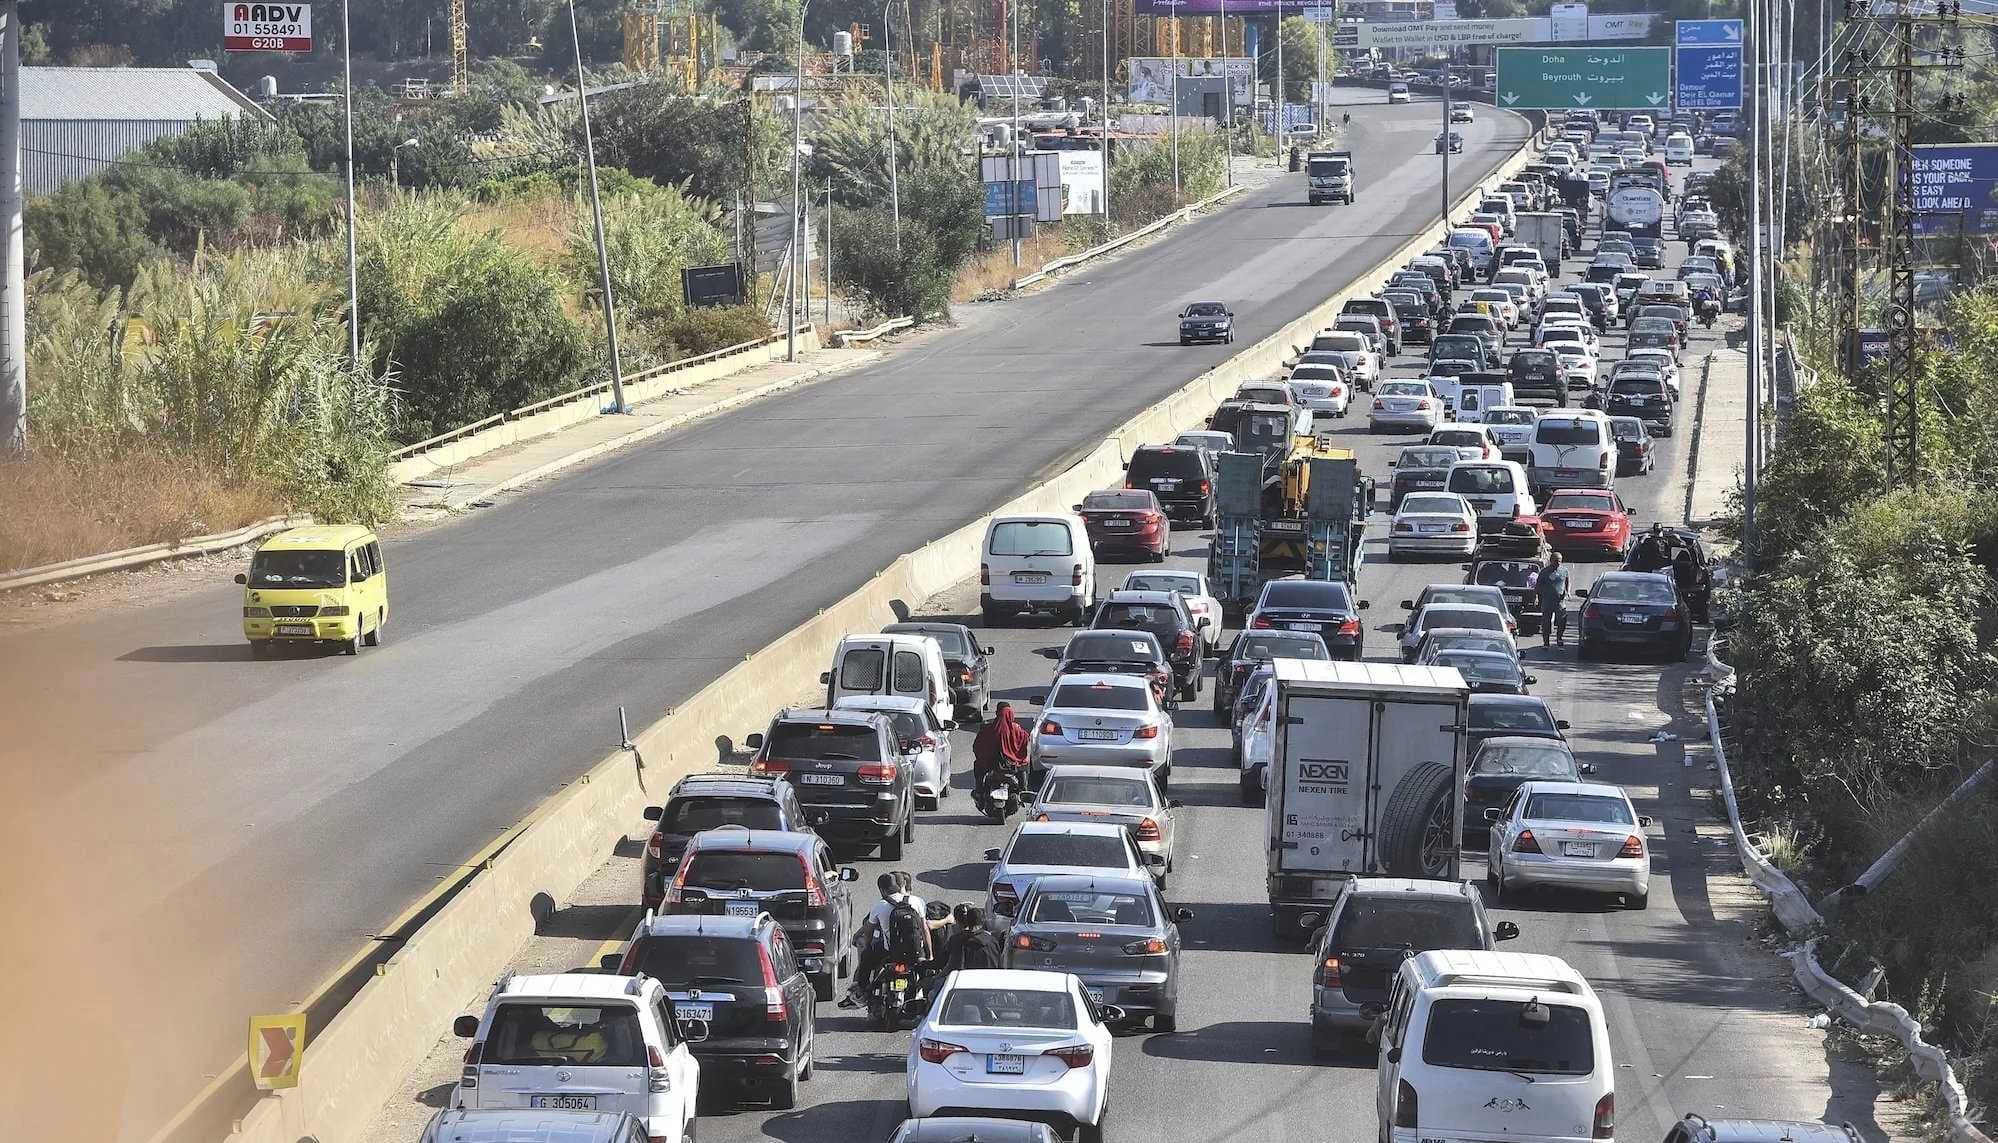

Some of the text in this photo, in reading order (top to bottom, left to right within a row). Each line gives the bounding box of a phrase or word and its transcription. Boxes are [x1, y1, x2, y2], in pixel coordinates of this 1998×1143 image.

[234, 4, 302, 22] AADV
[234, 23, 302, 35] 01 558491
[1372, 26, 1406, 34] Download
[1425, 24, 1438, 32] Pay
[251, 38, 284, 49] G20B
[1542, 55, 1565, 63] Doha
[1586, 54, 1625, 65] الدوحة
[1542, 72, 1582, 83] Beyrouth
[1586, 72, 1625, 84] بيروت
[1931, 158, 1973, 171] SOMEONE
[1923, 172, 1946, 184] YOUR
[1921, 185, 1945, 196] EASY
[1916, 197, 1939, 209] LOOK
[1299, 763, 1349, 780] NEXEN
[1298, 785, 1349, 795] NEXEN TIRE
[540, 1096, 589, 1109] G 305064
